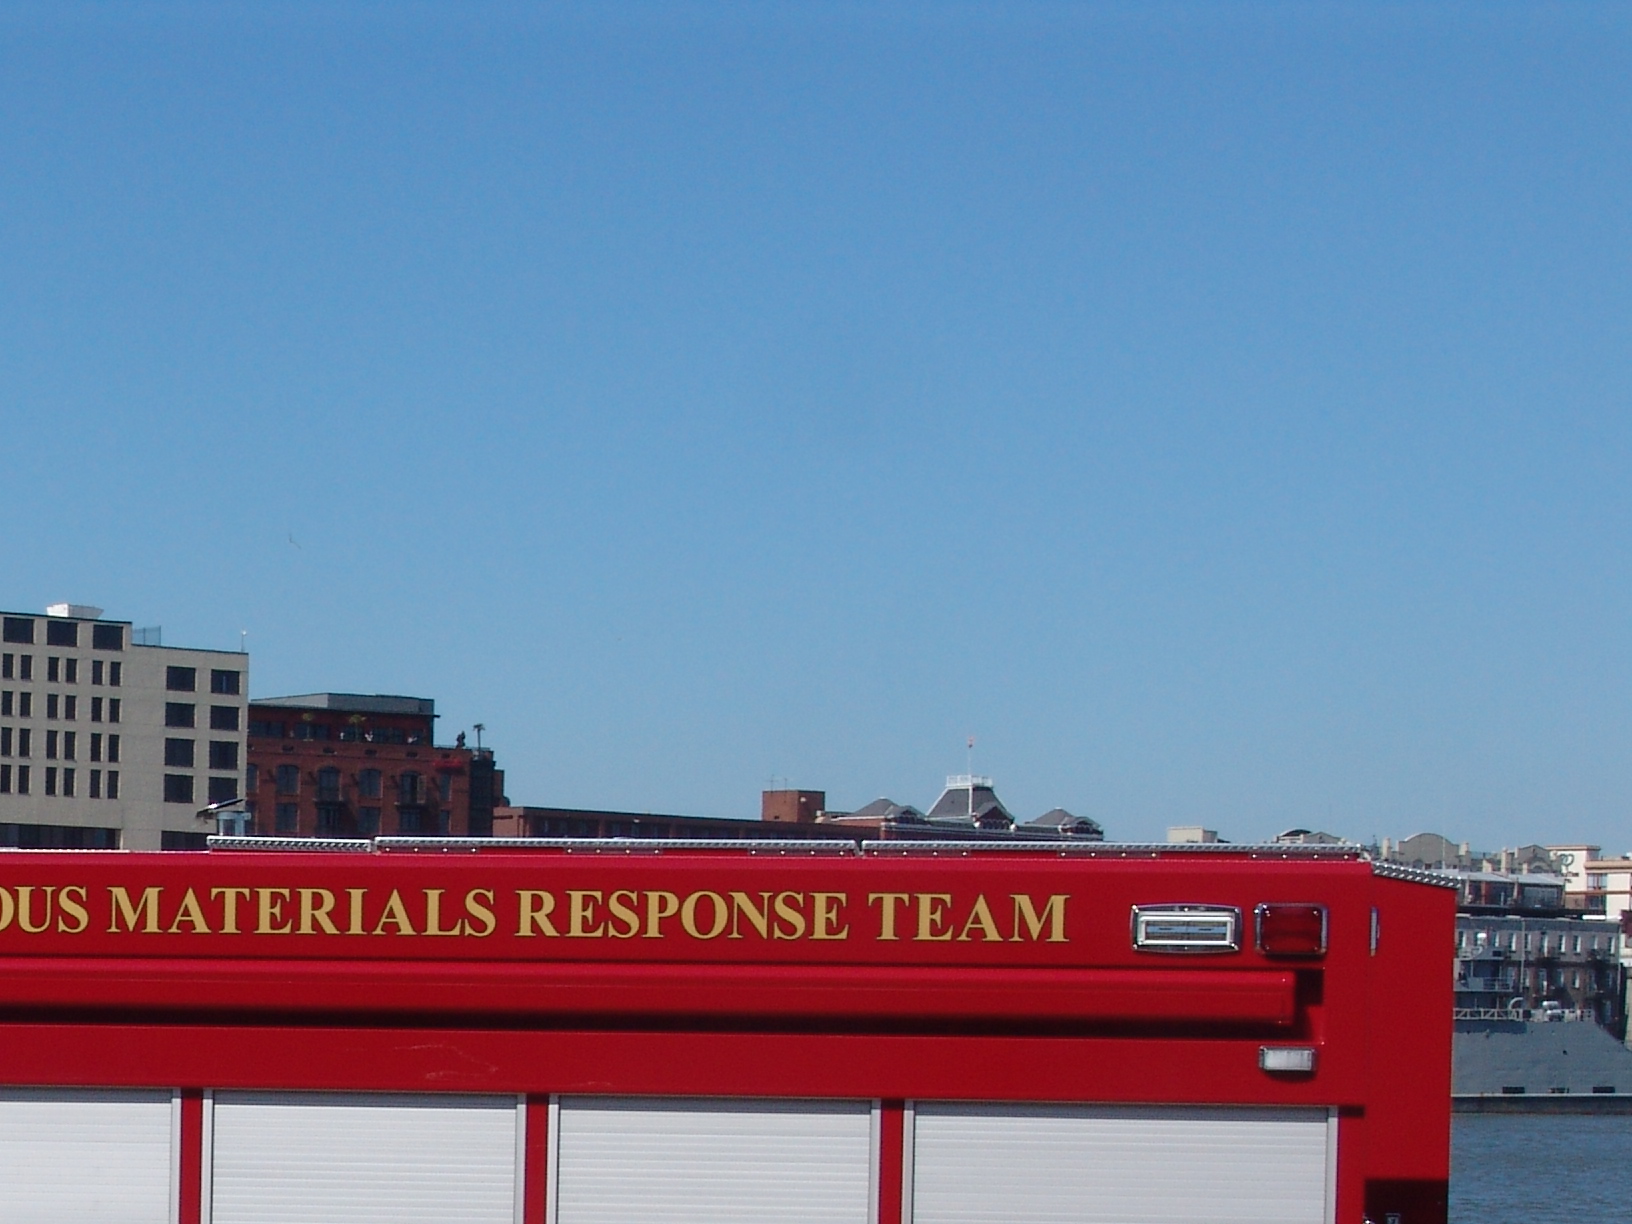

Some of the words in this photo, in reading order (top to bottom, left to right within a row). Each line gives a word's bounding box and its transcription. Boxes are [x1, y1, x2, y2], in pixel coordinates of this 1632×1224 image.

[106, 886, 496, 937] MATERIALS
[514, 890, 849, 941] RESPONSE
[868, 893, 1071, 943] TEAM
